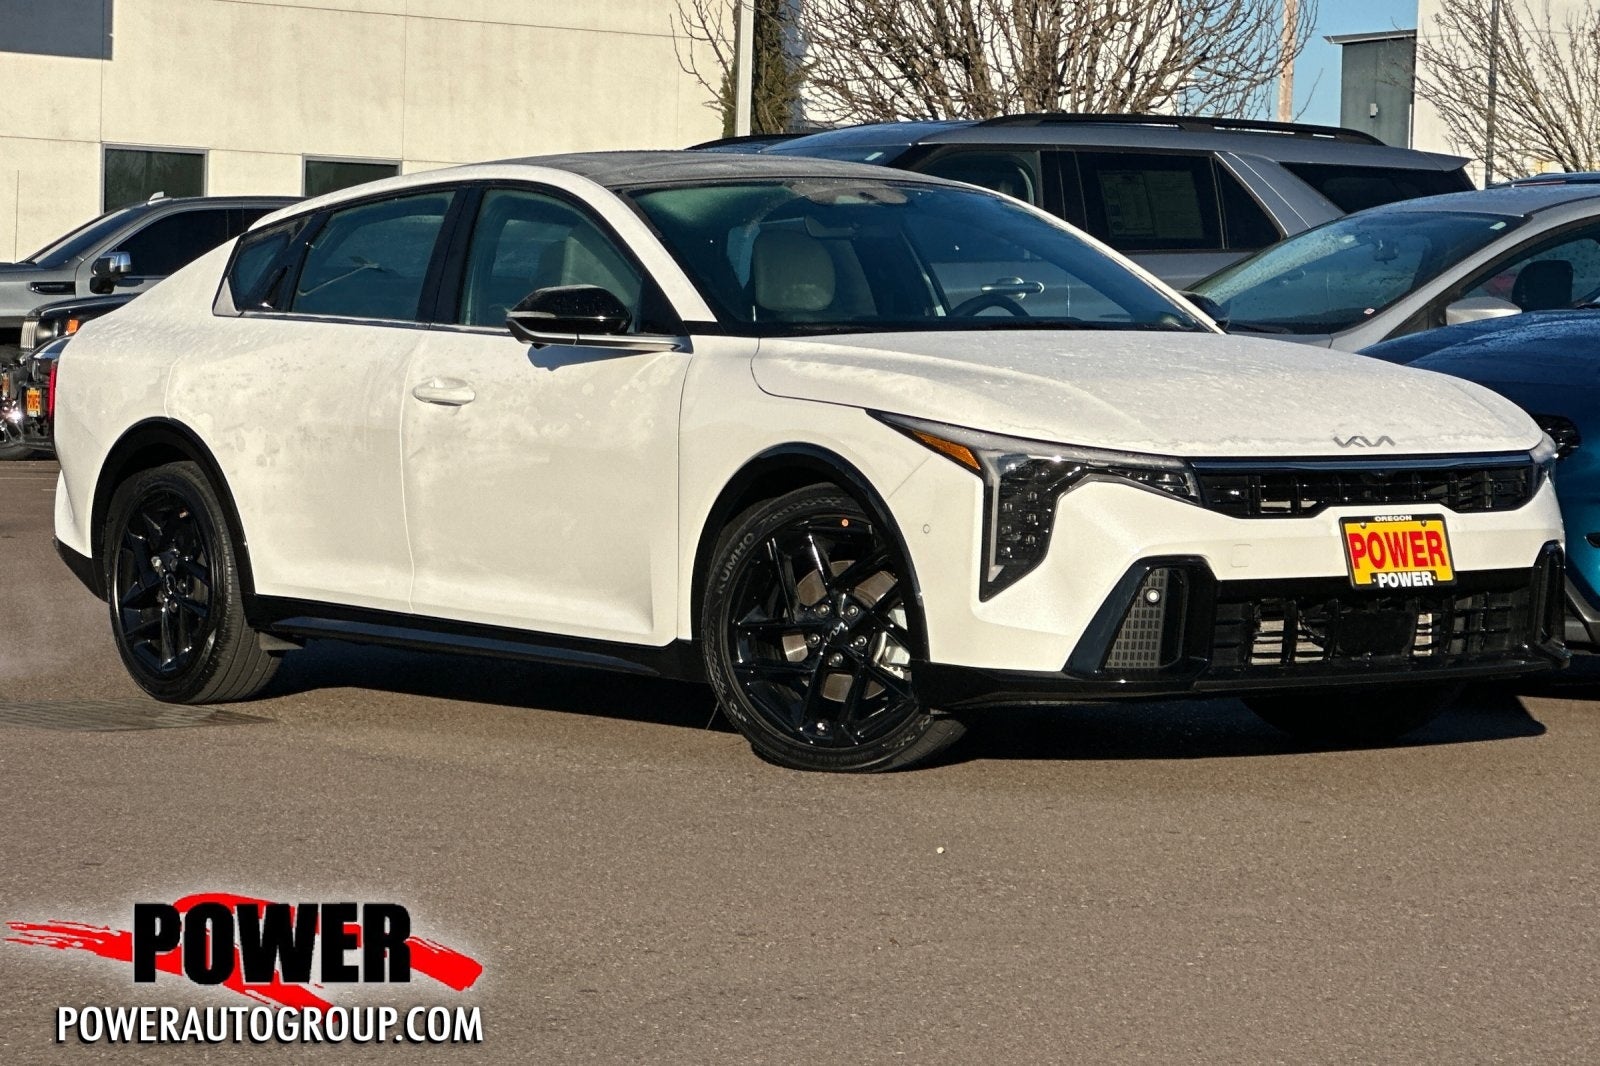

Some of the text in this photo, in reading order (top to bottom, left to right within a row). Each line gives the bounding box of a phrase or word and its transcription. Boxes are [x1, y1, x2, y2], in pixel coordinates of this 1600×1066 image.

[718, 532, 754, 594] KUMHO
[1348, 530, 1447, 570] POWER
[1377, 572, 1434, 588] POWER
